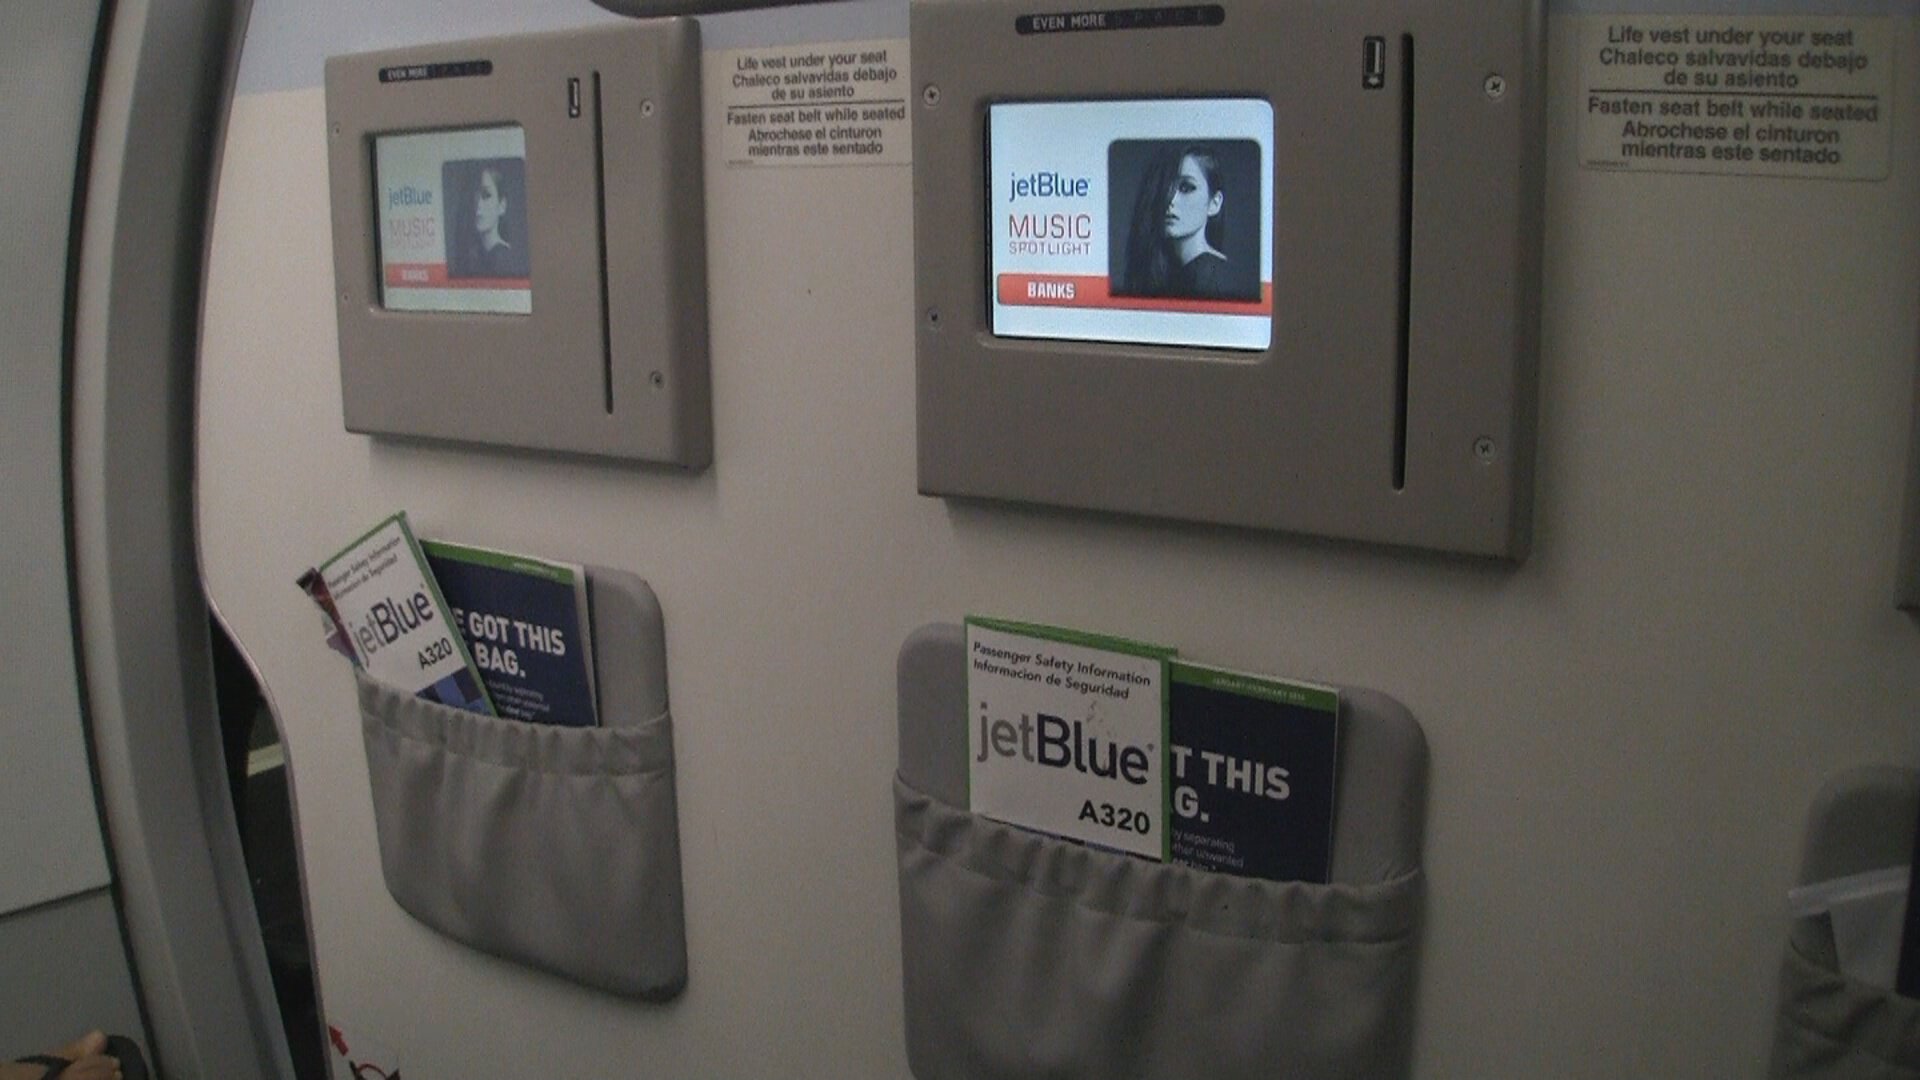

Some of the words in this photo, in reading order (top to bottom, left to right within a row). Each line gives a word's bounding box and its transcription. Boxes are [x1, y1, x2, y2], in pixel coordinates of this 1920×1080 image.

[1033, 15, 1067, 29] EVEN
[1071, 14, 1107, 28] MORE
[1608, 25, 1643, 43] Life
[1649, 27, 1690, 45] vest
[1696, 27, 1752, 46] under
[1759, 30, 1804, 49] your
[1811, 29, 1854, 46] seat
[737, 57, 758, 71] Life
[762, 56, 786, 69] vest
[790, 53, 825, 68] under
[829, 52, 857, 71] your
[860, 50, 887, 63] seat
[1599, 48, 1678, 66] Chaleco
[1685, 50, 1791, 68] salvavidas
[1798, 50, 1868, 73] debajo
[732, 72, 781, 88] Chaleco
[784, 69, 849, 84] salvavidas
[853, 68, 897, 84] debajo
[1664, 69, 1688, 86] de
[1694, 72, 1718, 87] su
[1724, 70, 1799, 89] asiento
[772, 88, 786, 101] de
[790, 88, 805, 100] su
[808, 85, 854, 98] asiento
[727, 111, 766, 125] Fasten
[770, 110, 795, 124] seat
[799, 108, 821, 122] belt
[825, 107, 858, 122] while
[862, 106, 905, 121] seated
[1588, 96, 1652, 115] Fasten
[1659, 99, 1700, 116] seat
[1707, 99, 1743, 118] belt
[1749, 101, 1802, 120] while
[1809, 103, 1878, 122] seated
[748, 127, 812, 142] Abrochese
[815, 126, 826, 140] el
[829, 126, 882, 140] cinturon
[1622, 121, 1728, 140] Abrochese
[1732, 123, 1750, 141] el
[1755, 124, 1840, 144] cinturon
[748, 143, 800, 157] mientras
[803, 143, 829, 156] este
[832, 141, 883, 155] sentado
[1621, 141, 1706, 160] mientras
[1712, 143, 1754, 161] este
[1758, 146, 1841, 164] sentado
[388, 186, 432, 209] jetBlue
[1010, 172, 1089, 201] jetBlue
[390, 217, 435, 238] MUSIC
[1009, 214, 1091, 238] MUSIC
[1009, 241, 1091, 255] SPOTLIGHT
[1027, 282, 1075, 299] BANKS
[352, 590, 434, 669] jetBlue
[452, 608, 466, 635] E
[469, 611, 510, 644] GOT
[513, 621, 566, 657] THIS
[417, 637, 453, 670] A320
[474, 641, 526, 678] BAG.
[973, 641, 1031, 665] Passenger
[1035, 654, 1075, 674] Safety
[1078, 662, 1151, 686] Information
[973, 659, 1042, 682] Informacion
[1046, 673, 1062, 687] de
[1065, 677, 1130, 700] Seguridad
[976, 702, 1149, 785] jetBlue
[1170, 745, 1193, 778] T
[1201, 751, 1290, 800] THIS
[1174, 785, 1210, 823] G.
[1078, 800, 1151, 835] A320
